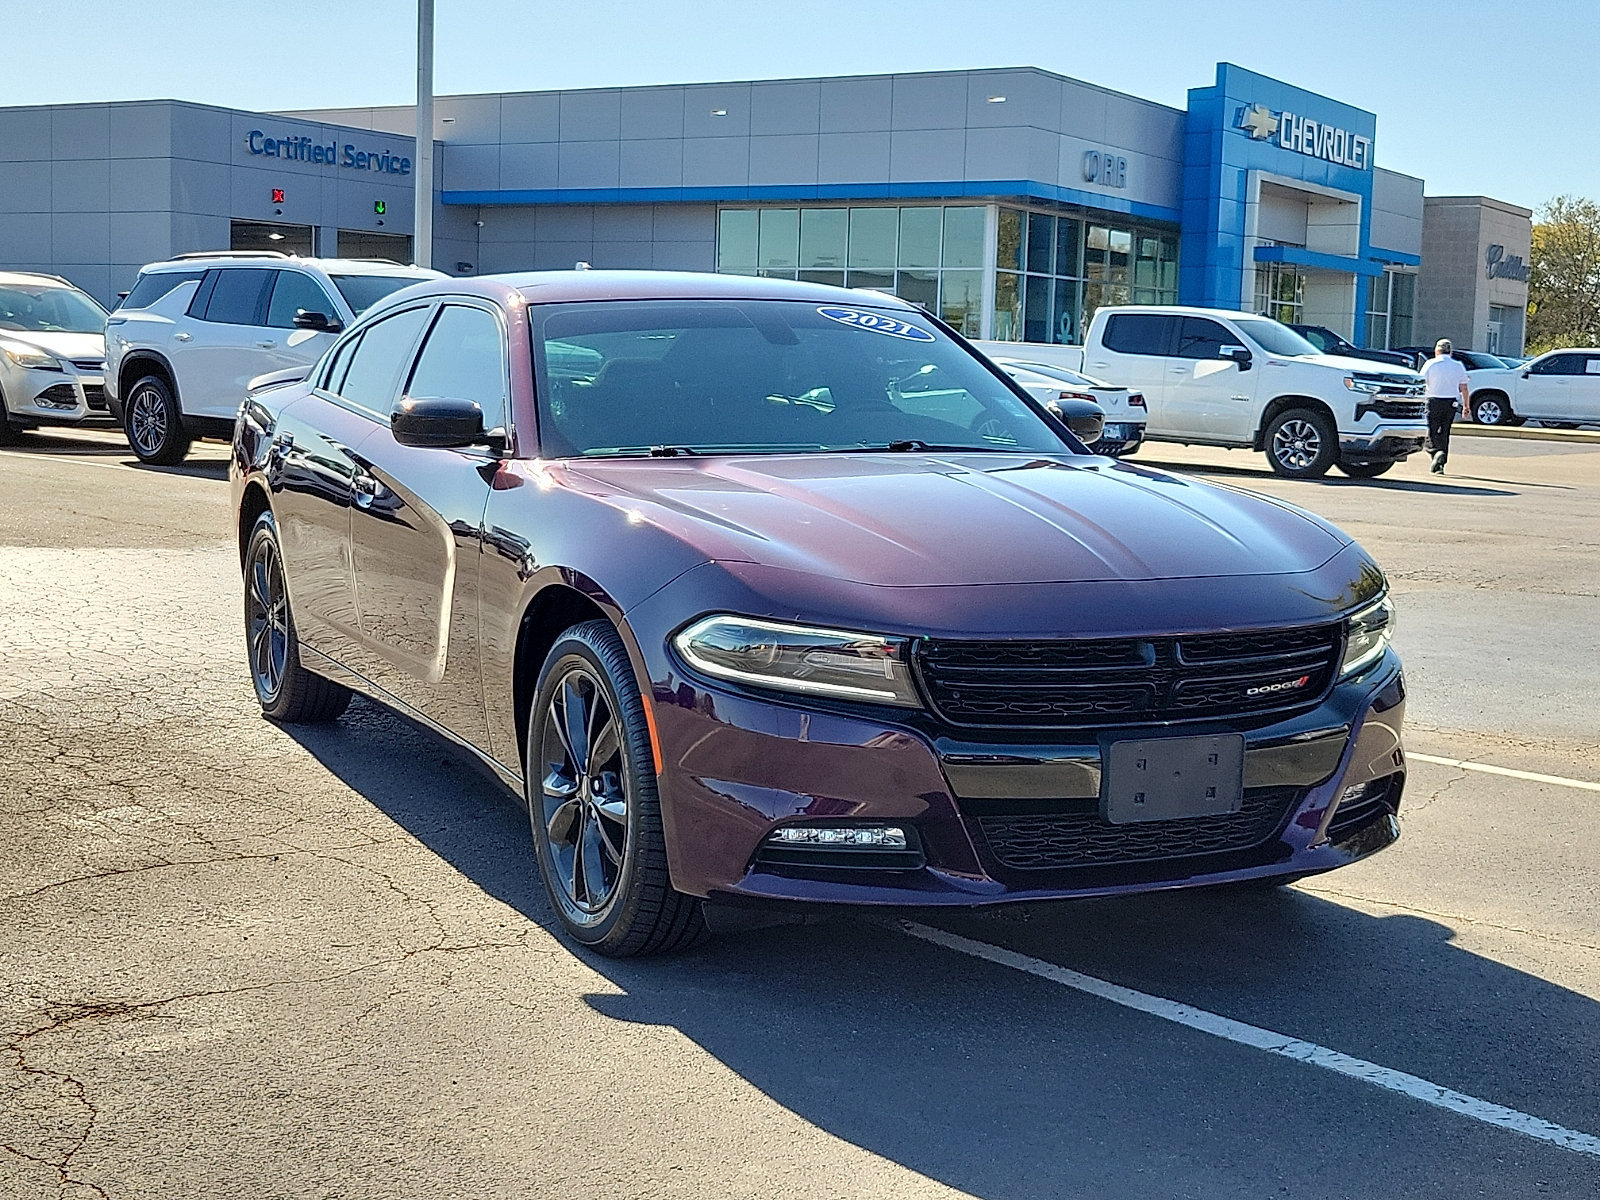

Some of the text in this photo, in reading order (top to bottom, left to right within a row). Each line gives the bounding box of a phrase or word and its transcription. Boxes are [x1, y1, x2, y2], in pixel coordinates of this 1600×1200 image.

[248, 130, 411, 175] Certified Service
[1279, 111, 1371, 170] CHEVROLET
[1083, 150, 1127, 189] ORR
[839, 311, 911, 336] 2021
[1247, 679, 1301, 695] DODGE
